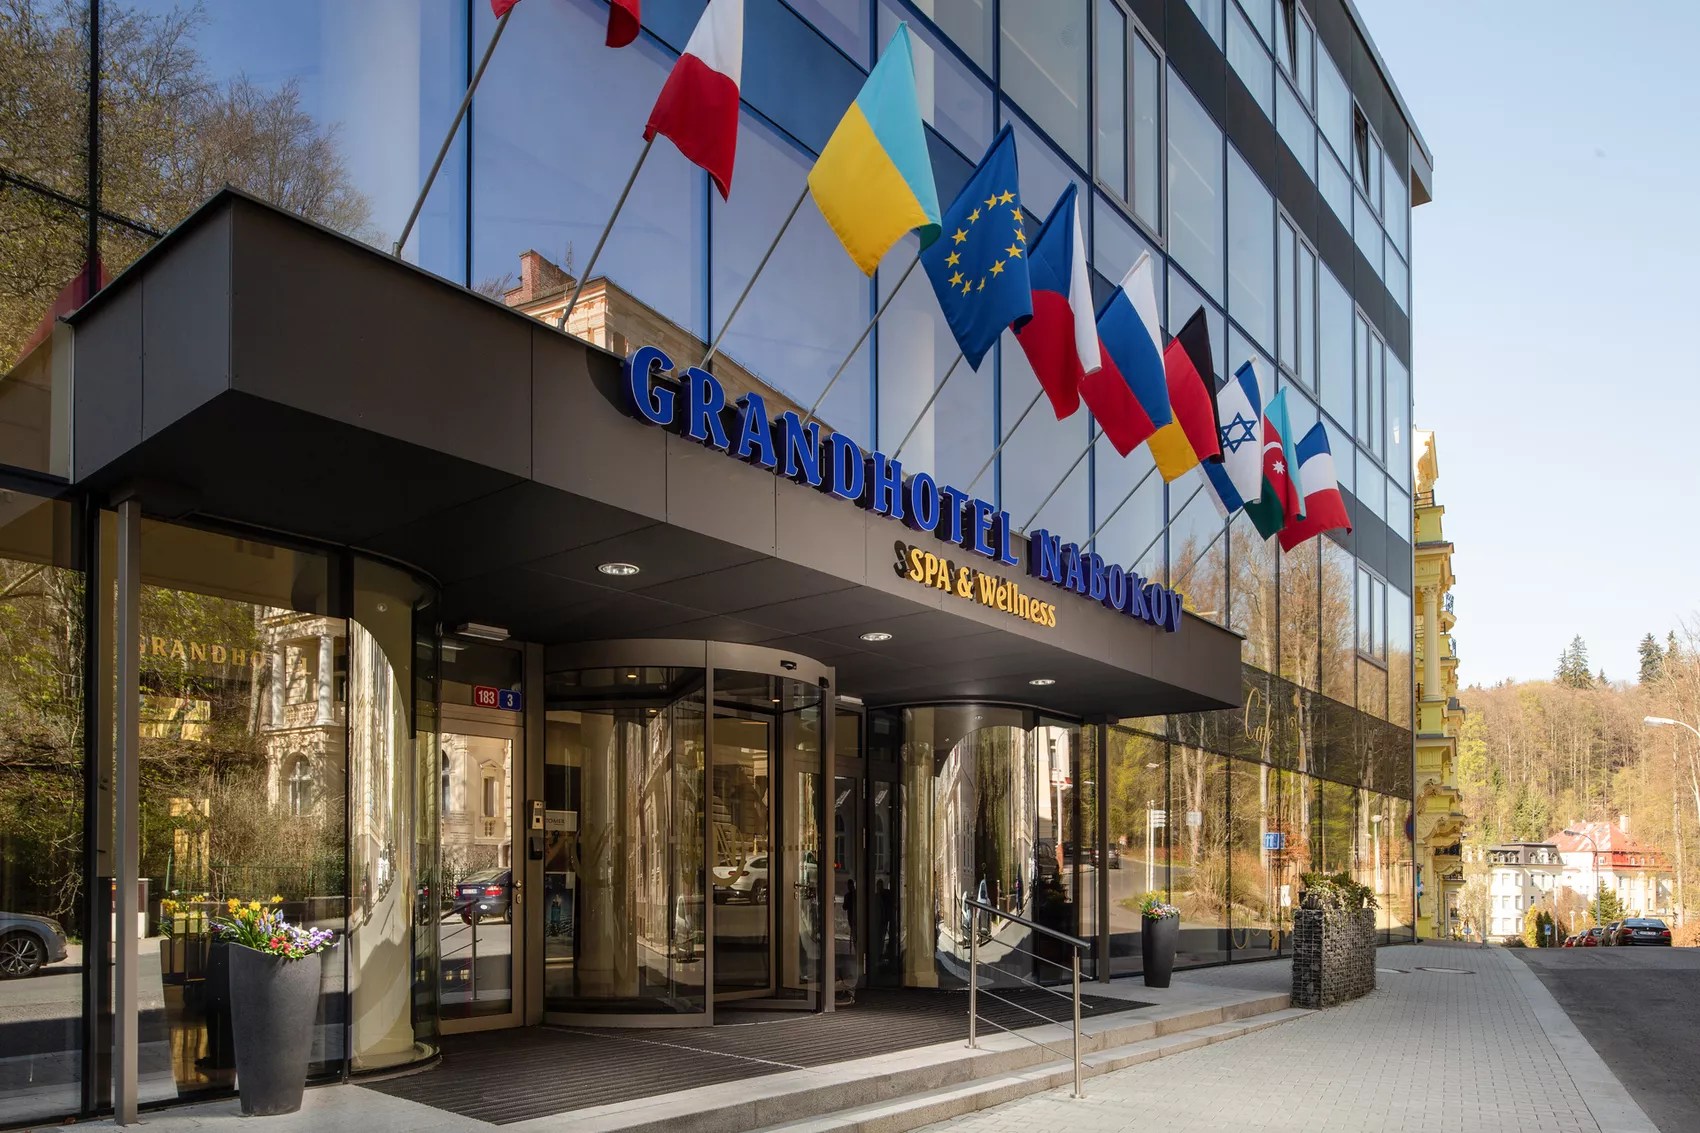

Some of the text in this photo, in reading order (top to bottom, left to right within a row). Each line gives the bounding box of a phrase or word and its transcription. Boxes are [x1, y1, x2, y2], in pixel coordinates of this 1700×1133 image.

[628, 345, 1184, 632] GRANDHOTEL NABOKOV
[909, 548, 1057, 628] SPA & Wellness
[478, 690, 495, 705] 183
[507, 694, 514, 707] 3
